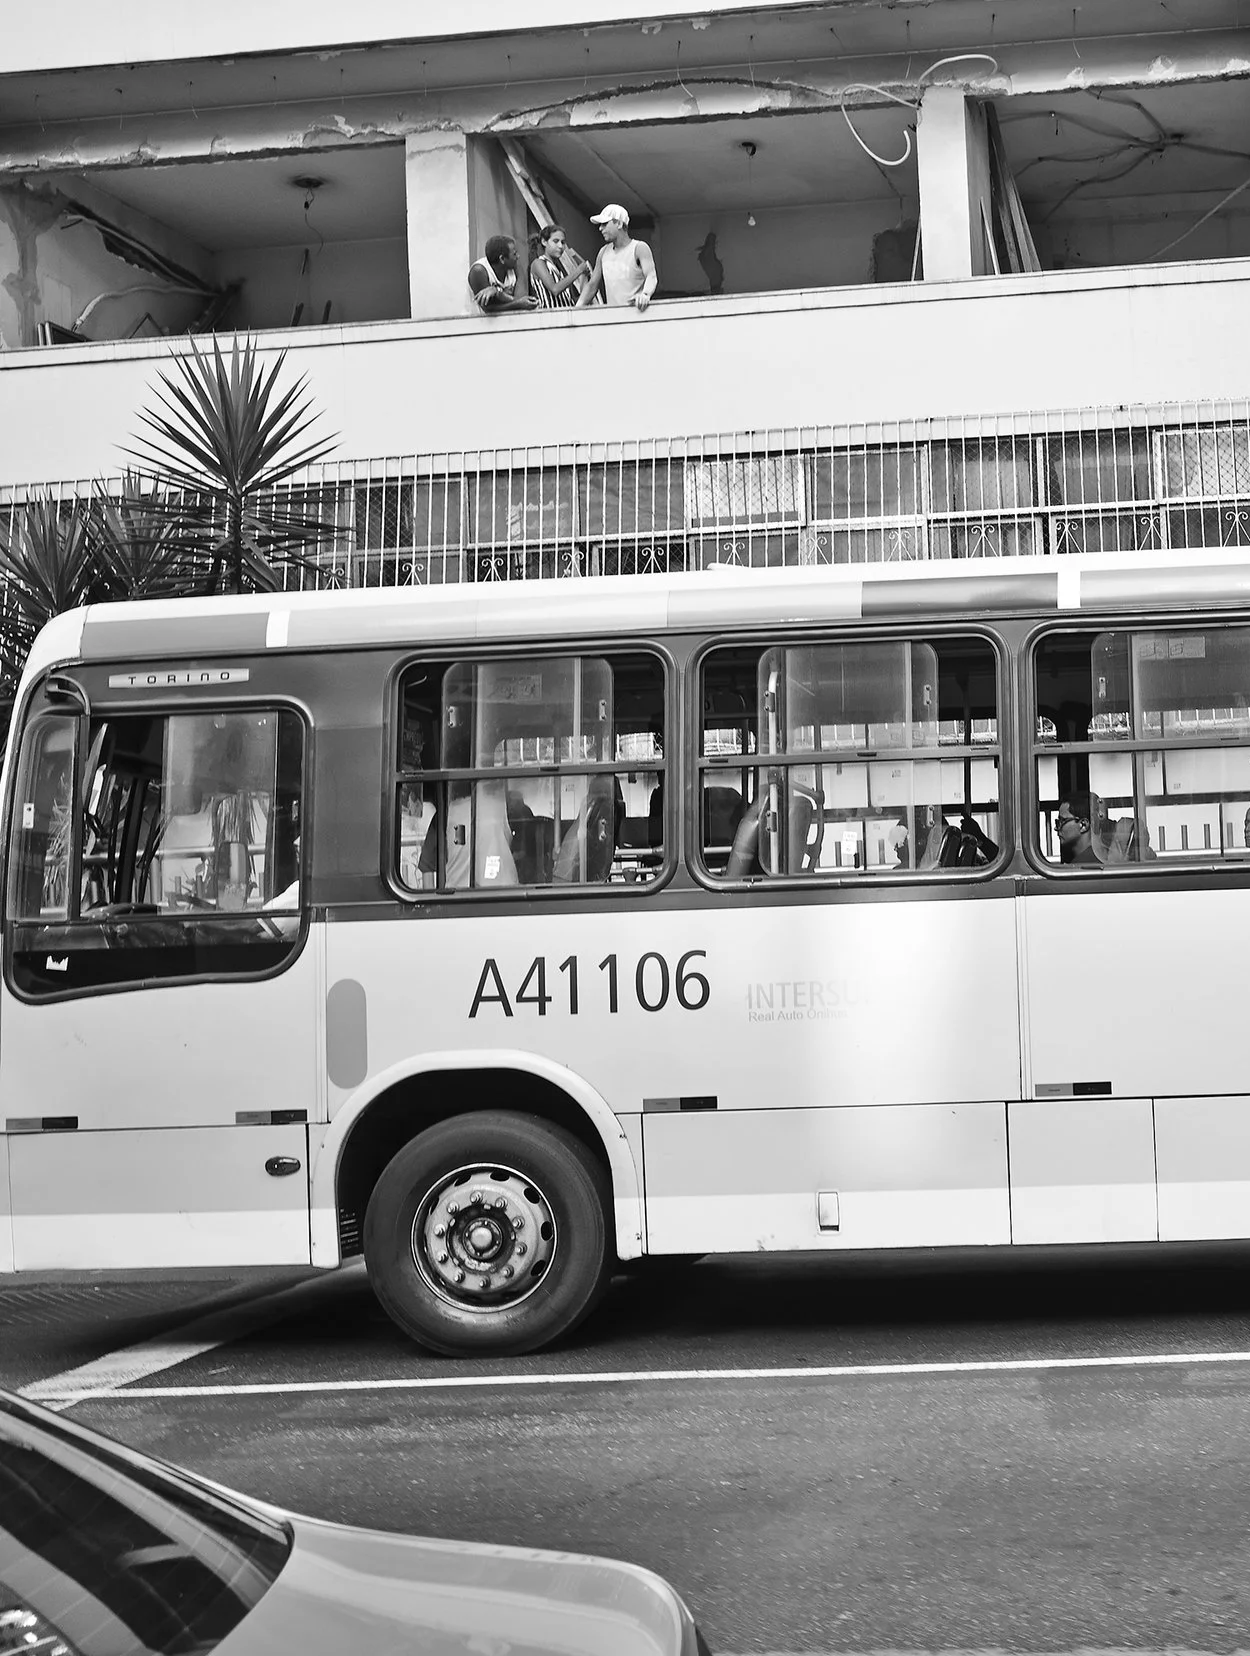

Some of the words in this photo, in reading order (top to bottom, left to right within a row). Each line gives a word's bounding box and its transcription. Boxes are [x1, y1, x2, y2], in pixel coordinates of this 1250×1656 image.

[128, 671, 230, 685] TORINO
[468, 949, 711, 1018] A41106
[748, 1011, 774, 1022] Real
[777, 1010, 803, 1020] Auto
